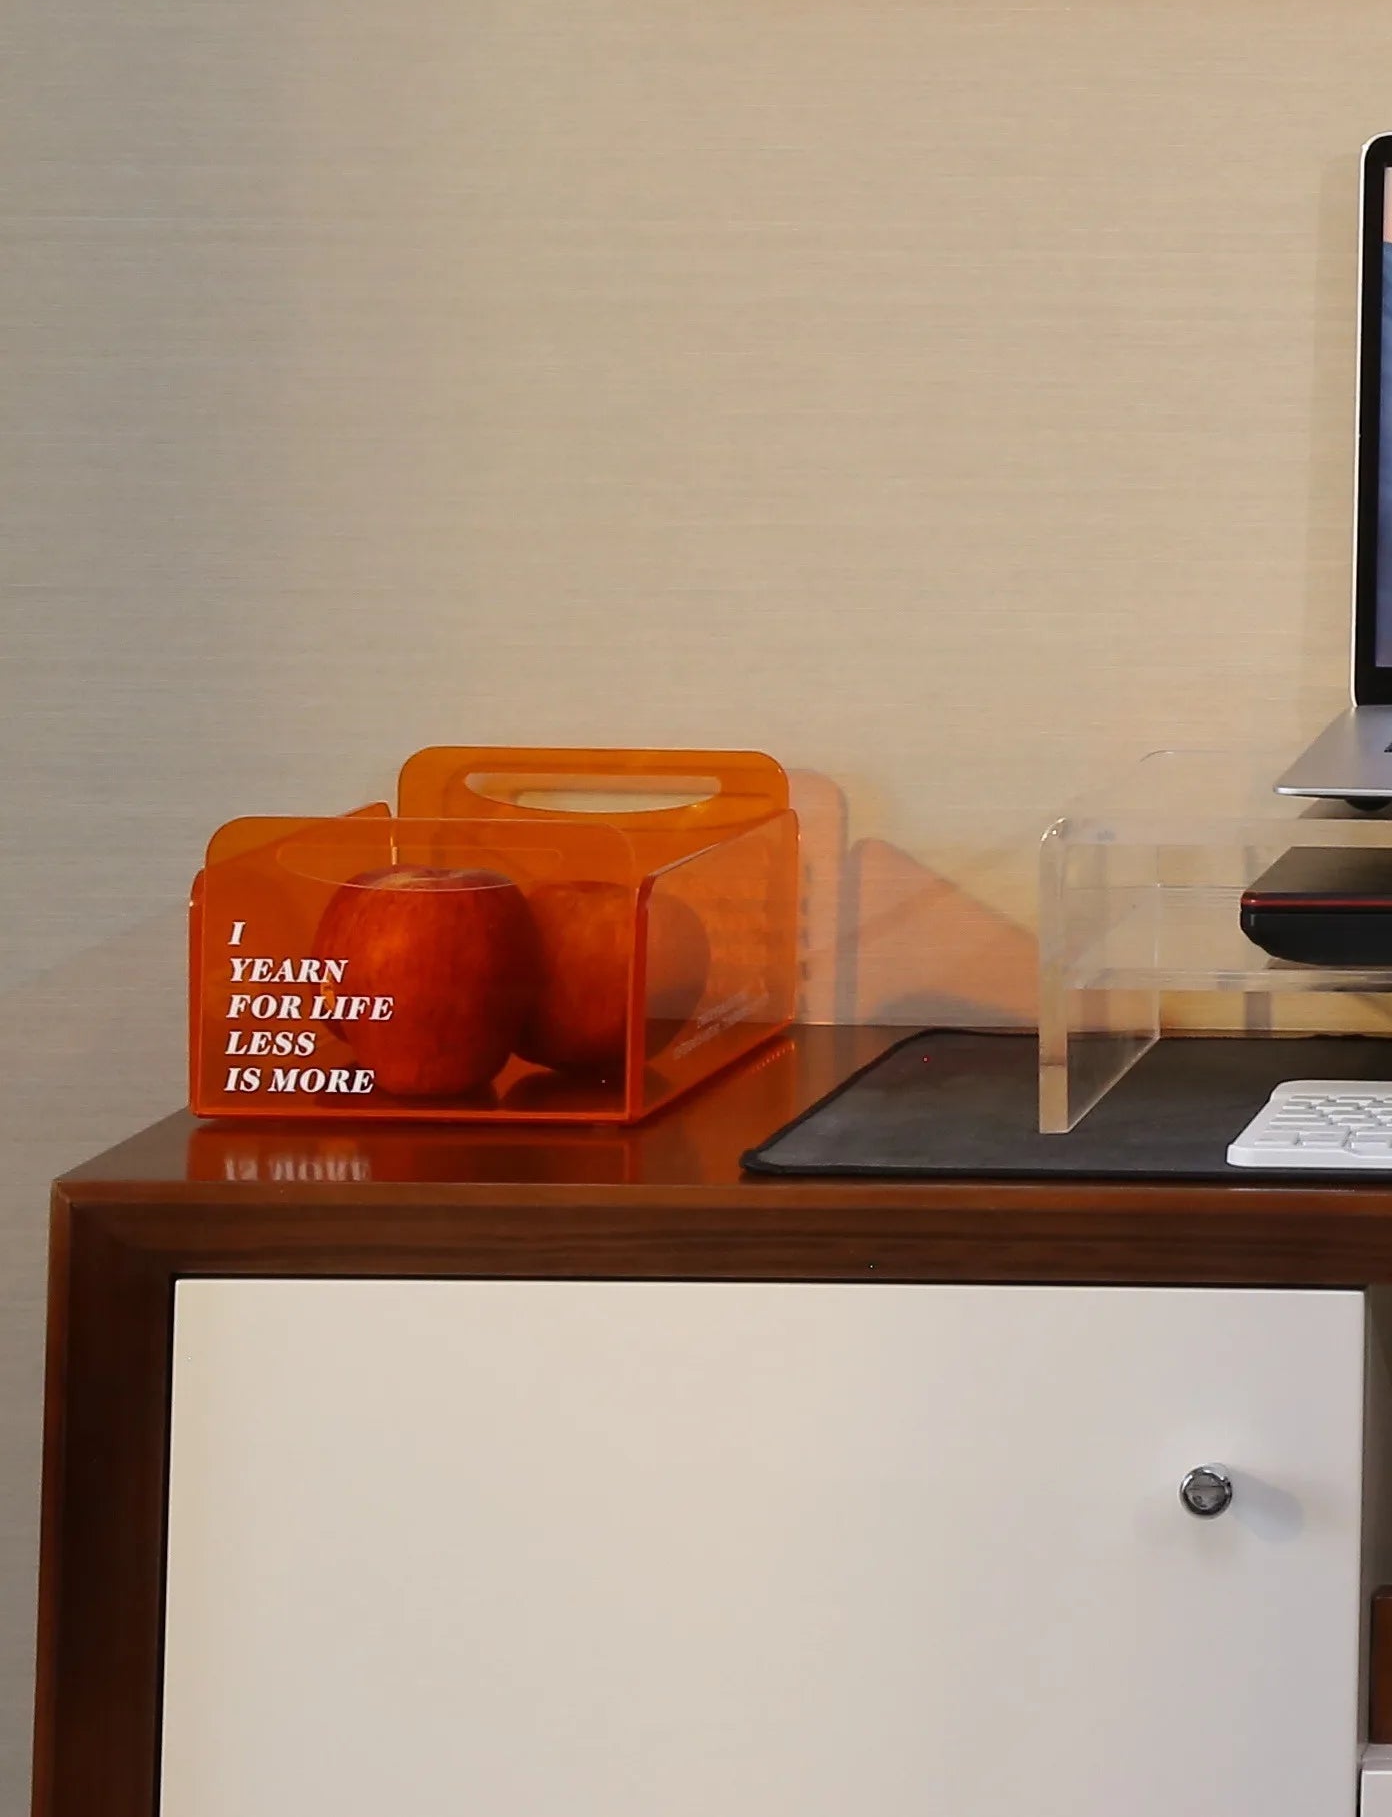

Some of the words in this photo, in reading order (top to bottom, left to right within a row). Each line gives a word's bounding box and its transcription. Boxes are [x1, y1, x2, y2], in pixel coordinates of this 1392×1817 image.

[228, 921, 246, 945] I
[230, 958, 349, 983] YEARN
[226, 994, 301, 1019] FOR
[309, 996, 394, 1021] LIFE
[225, 1031, 316, 1056] LESS
[224, 1067, 262, 1092] IS
[267, 1068, 375, 1094] MORE
